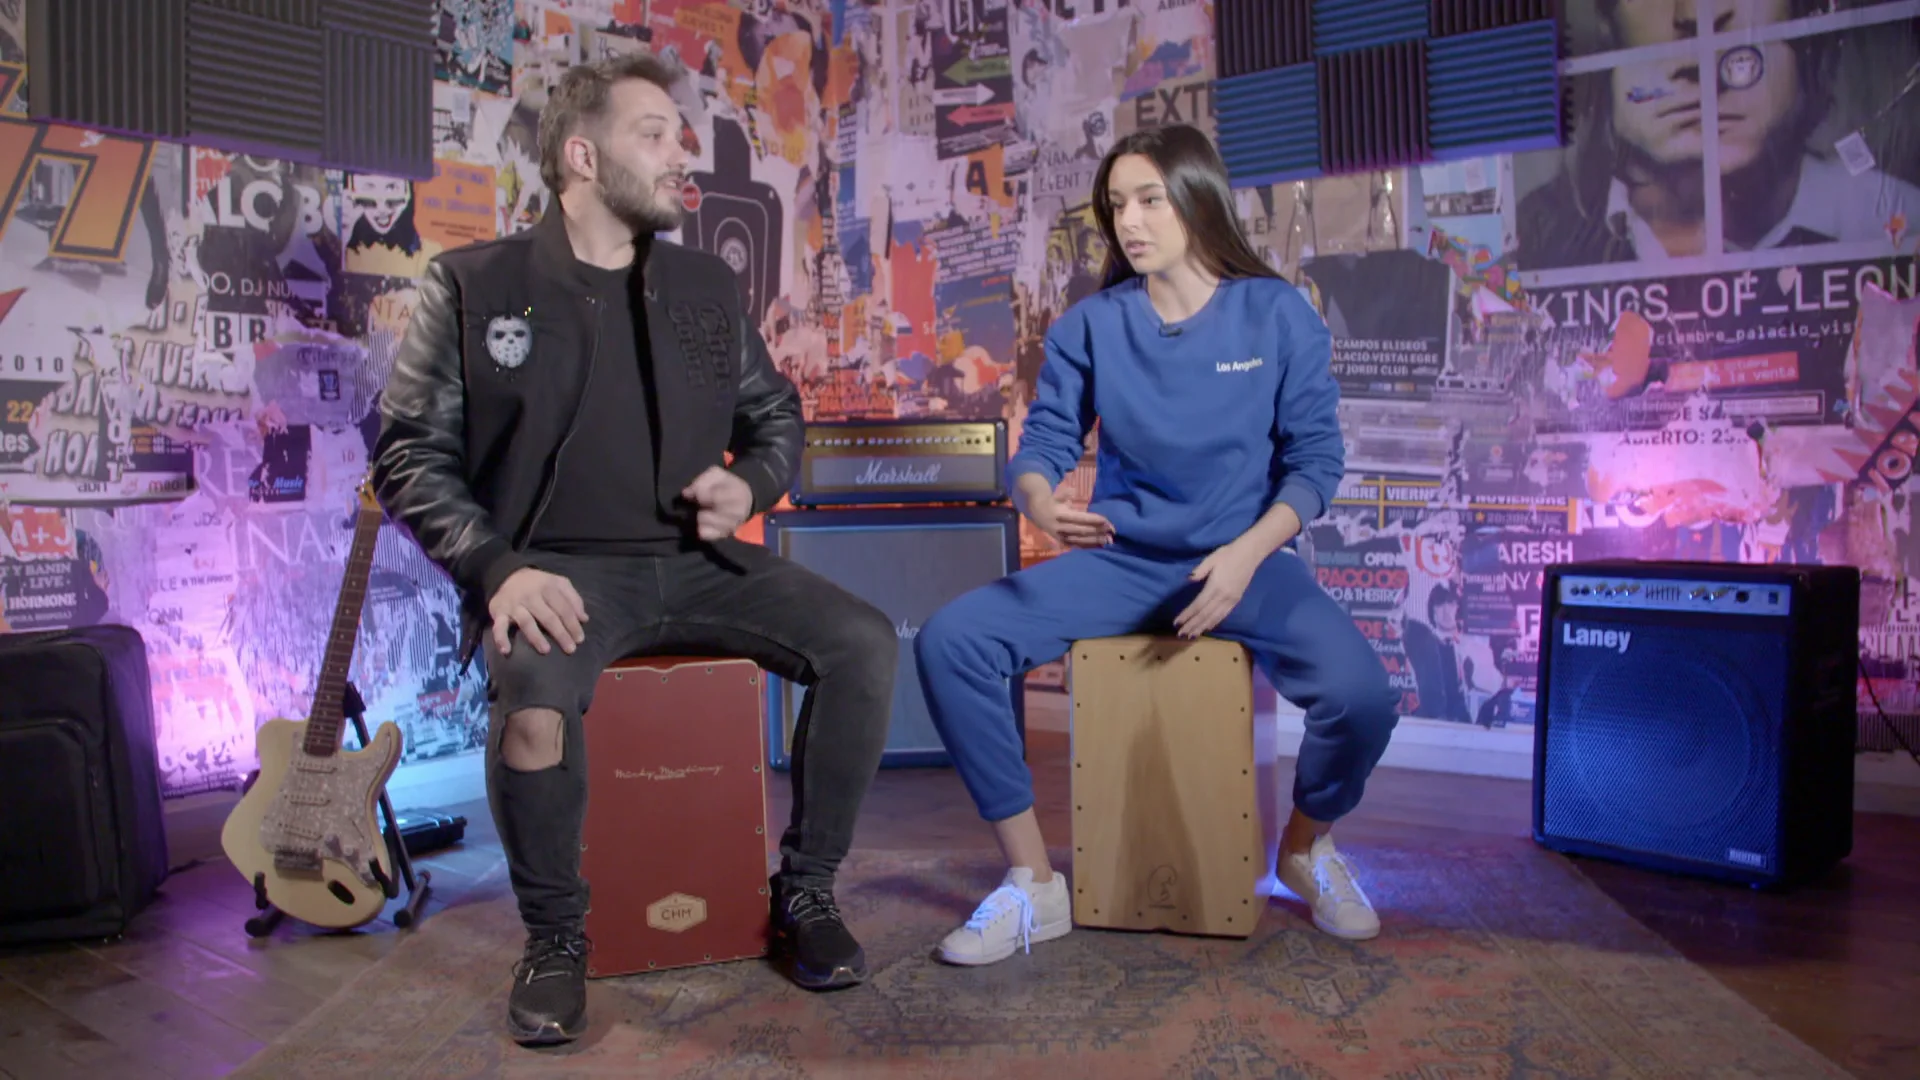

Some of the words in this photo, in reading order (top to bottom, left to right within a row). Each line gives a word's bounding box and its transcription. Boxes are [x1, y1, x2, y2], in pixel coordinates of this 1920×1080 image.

[240, 277, 263, 297] DJ
[1336, 339, 1380, 351] CAMPOS
[1382, 340, 1428, 352] ELISEOS
[1216, 361, 1231, 372] Los
[1232, 357, 1263, 372] Angeles
[1372, 352, 1438, 364] VISTALEGRE
[1346, 364, 1378, 376] JORDI
[1380, 365, 1409, 376] CLUB
[6, 400, 34, 424] 22
[855, 459, 942, 485] Marshall
[273, 476, 303, 490] Music
[1562, 623, 1631, 653] Laney
[660, 908, 693, 921] CHM
